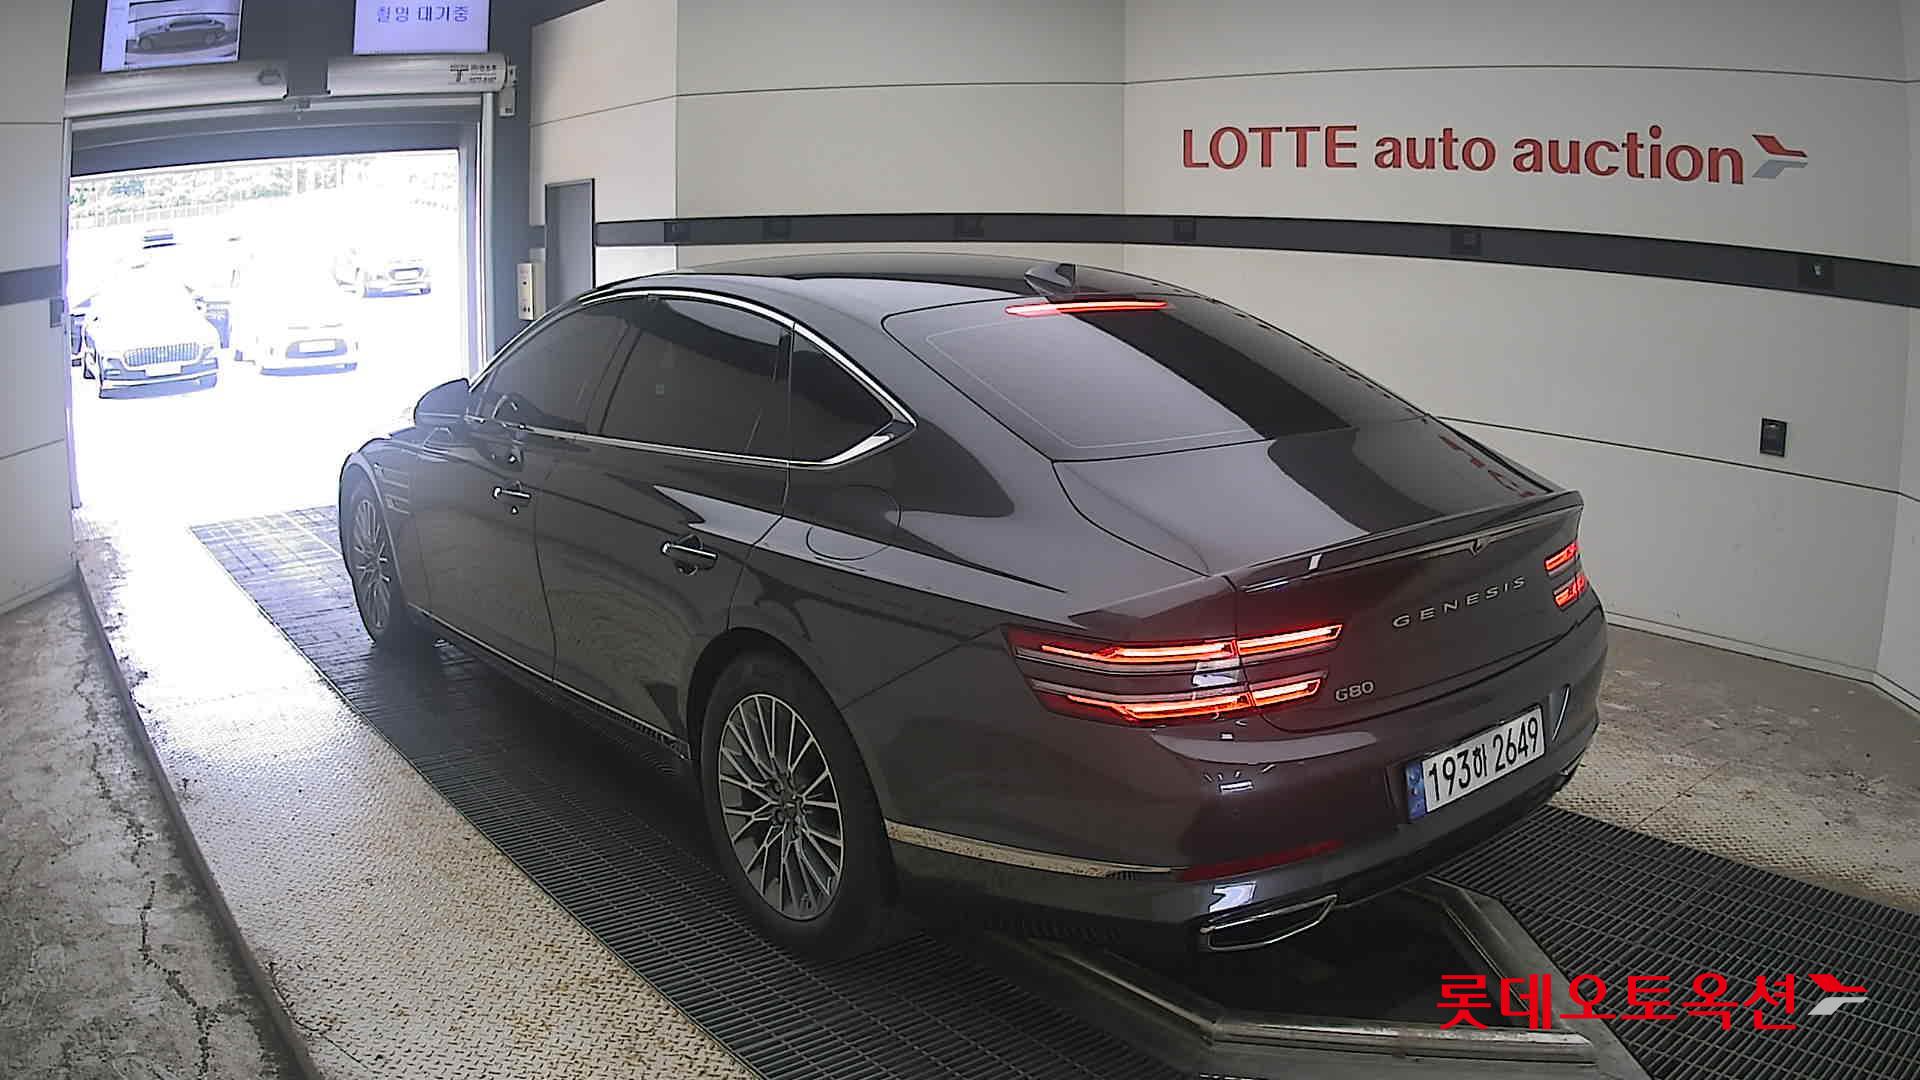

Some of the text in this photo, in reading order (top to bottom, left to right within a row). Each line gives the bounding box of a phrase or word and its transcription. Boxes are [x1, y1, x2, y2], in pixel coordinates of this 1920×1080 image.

[418, 5, 469, 22] 대기중
[1183, 125, 1744, 184] LOTTE auto auction
[1392, 576, 1526, 628] GENESIS
[1335, 681, 1375, 702] G80
[1428, 717, 1538, 801] 193하 2649
